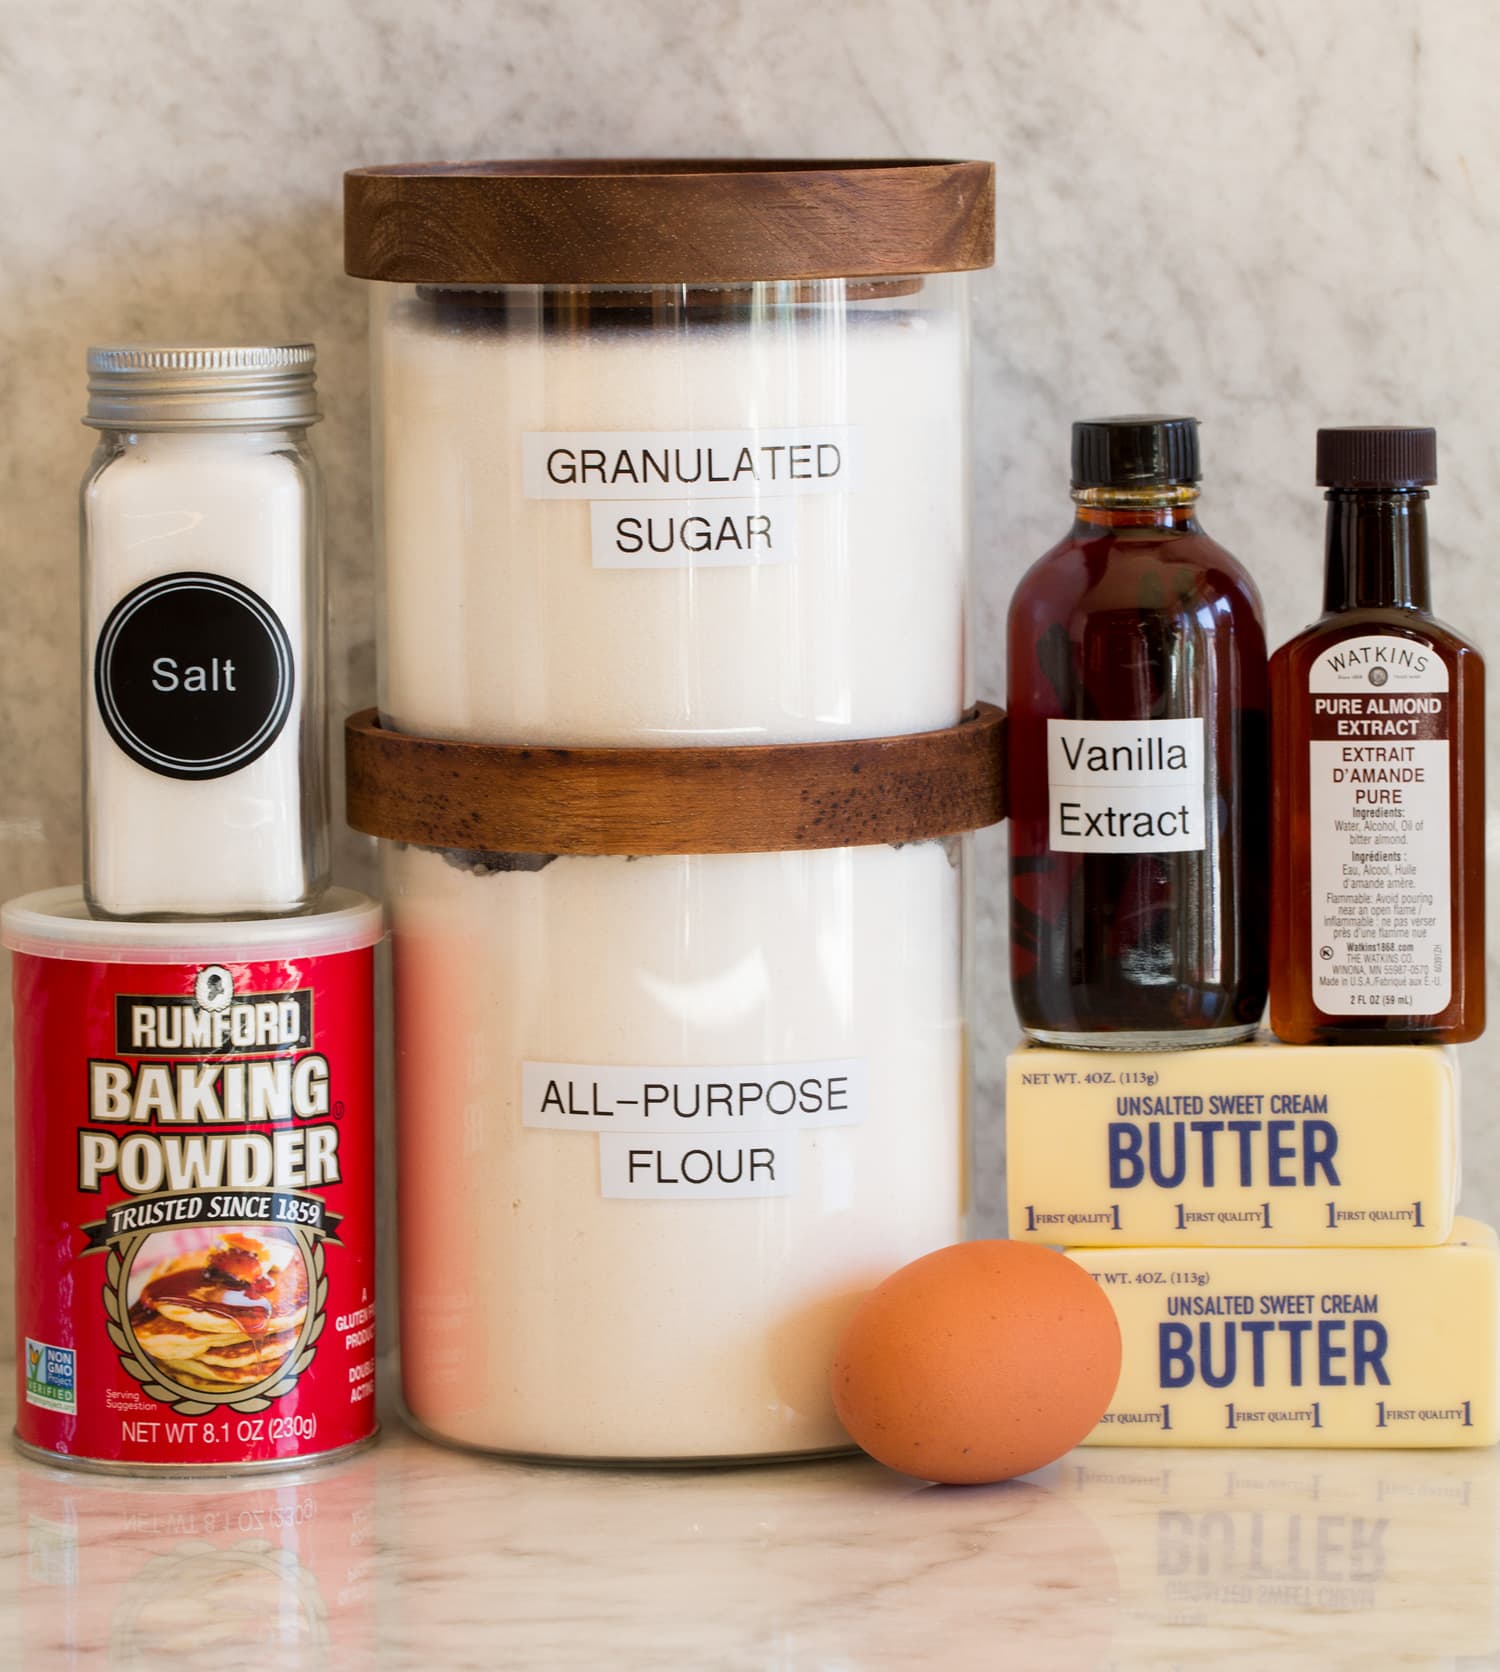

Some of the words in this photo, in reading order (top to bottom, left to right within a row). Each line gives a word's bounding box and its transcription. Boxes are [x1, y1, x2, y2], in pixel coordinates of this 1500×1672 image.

[546, 443, 841, 484] GRANULATED
[615, 515, 773, 553] SUGAR
[1327, 647, 1429, 672] WATKINS
[151, 656, 236, 692] Salt
[1315, 698, 1362, 715] PURE
[1366, 697, 1442, 714] ALMOND
[1337, 719, 1419, 735] EXTRACT
[1060, 736, 1188, 772] Vanilla
[1342, 747, 1415, 762] EXTRAIT
[1333, 768, 1425, 783] D'AMANDE
[1355, 789, 1403, 804] PURE
[1060, 803, 1190, 837] Extract
[1352, 807, 1405, 820] Ingredients:
[1334, 820, 1360, 832] Water,
[1364, 820, 1398, 832] Alcohol,
[1415, 820, 1424, 831] of
[1350, 995, 1356, 1005] 2
[1358, 995, 1367, 1005] FL
[1369, 995, 1380, 1005] OZ
[131, 1000, 301, 1048] RUMFORD
[89, 1054, 330, 1123] BAKING
[1021, 1071, 1050, 1086] NET
[1052, 1071, 1081, 1086] WT.
[1119, 1070, 1160, 1087] (113g)
[540, 1077, 848, 1118] ALL-PURPOSE
[1117, 1095, 1203, 1117] UNSALTED
[1209, 1095, 1265, 1116] SWEET
[1270, 1094, 1328, 1115] CREAM
[78, 1124, 341, 1192] POWDER
[628, 1148, 775, 1185] FLOUR
[1108, 1120, 1342, 1190] BUTTER
[112, 1197, 203, 1233] TRUSTED
[208, 1196, 271, 1219] SINCE
[276, 1198, 321, 1224] 1859
[1104, 1272, 1132, 1285] WT.
[1170, 1271, 1210, 1287] (113g)
[1167, 1295, 1254, 1317] UNSALTED
[1260, 1295, 1315, 1316] SWEET
[1321, 1294, 1378, 1315] CREAM
[335, 1307, 368, 1332] GLUTEN
[47, 1350, 72, 1364] NON
[1158, 1319, 1391, 1390] BUTTER
[47, 1362, 72, 1376] GMO
[105, 1389, 140, 1402] Serving
[106, 1399, 157, 1412] Suggestion
[121, 1421, 161, 1443] NET
[165, 1422, 199, 1443] WT
[203, 1421, 230, 1443] 8.1
[236, 1420, 265, 1442] OZ
[268, 1413, 318, 1444] (230g)
